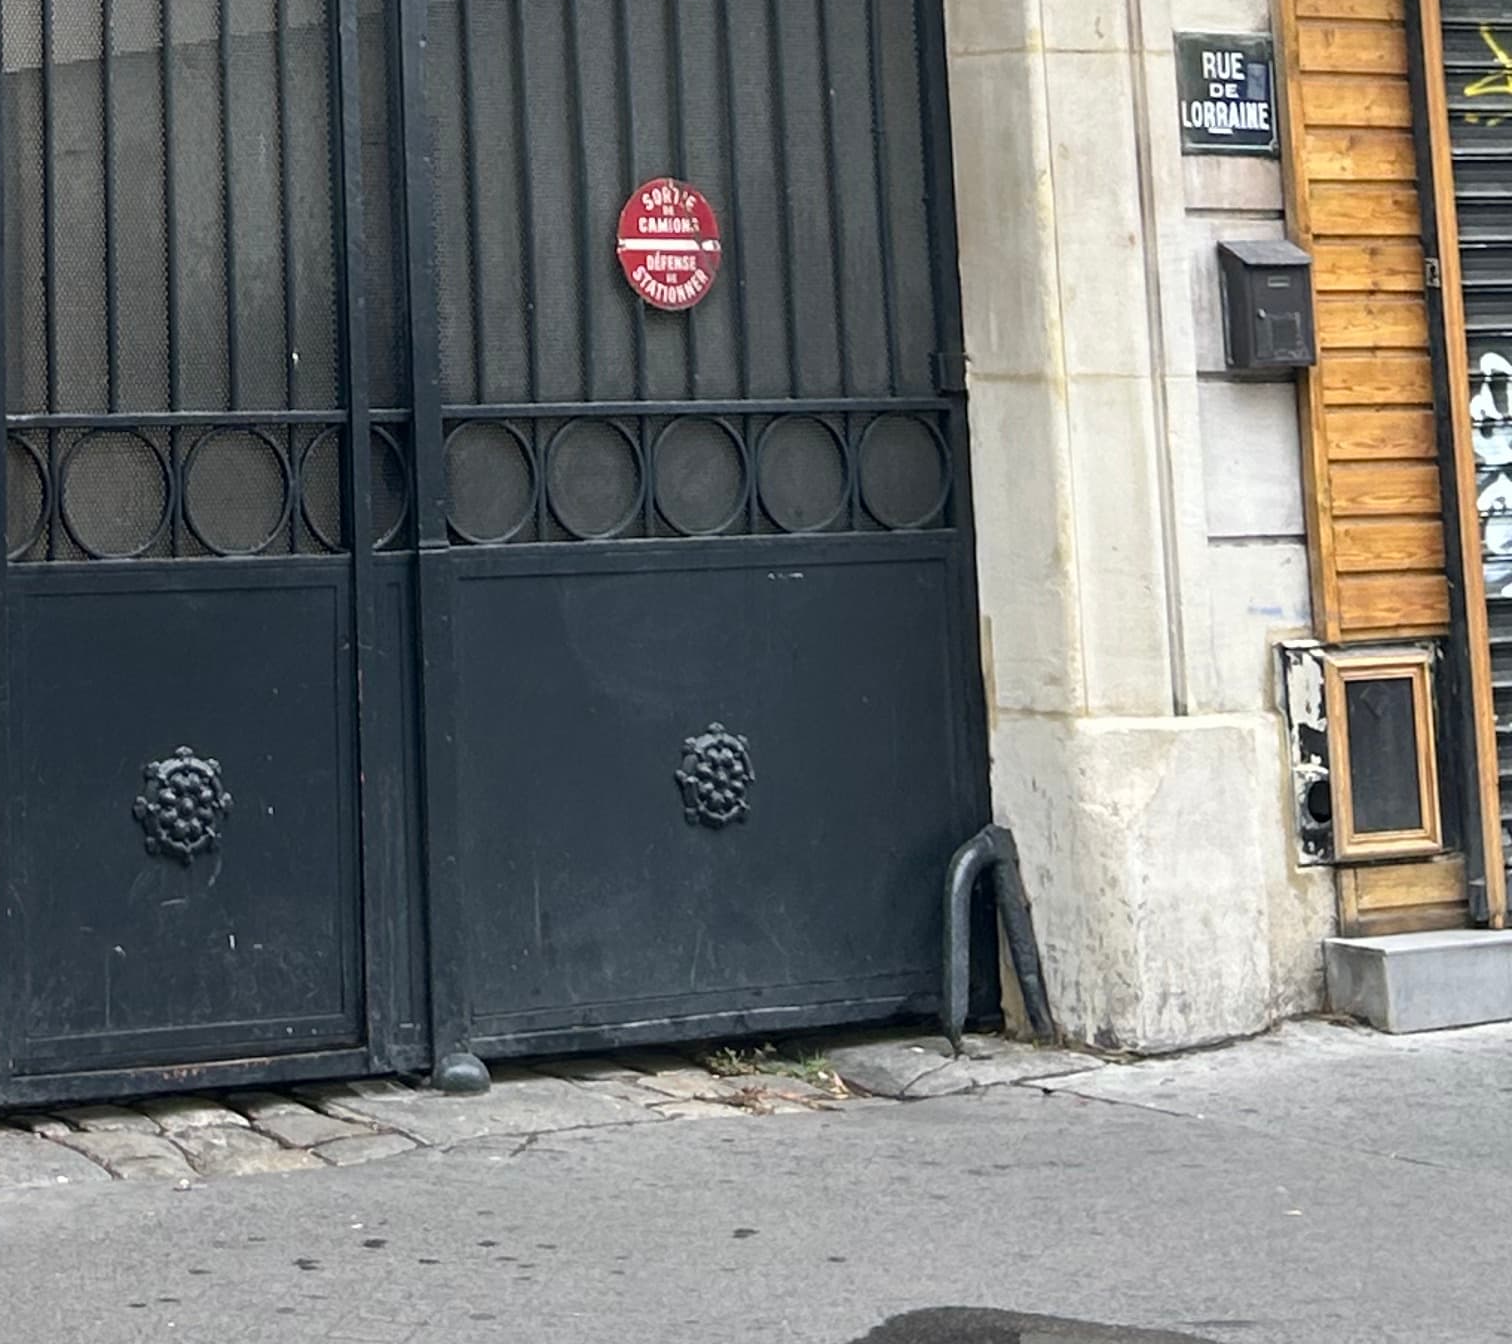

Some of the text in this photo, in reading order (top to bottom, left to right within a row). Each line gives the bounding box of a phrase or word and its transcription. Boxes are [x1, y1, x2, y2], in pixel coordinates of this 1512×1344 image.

[1201, 50, 1246, 81] RUE
[1208, 82, 1239, 99] DE
[1181, 100, 1271, 131] LORRAINE
[646, 250, 697, 271] DÉFENSE
[631, 265, 709, 304] STATIONNER
